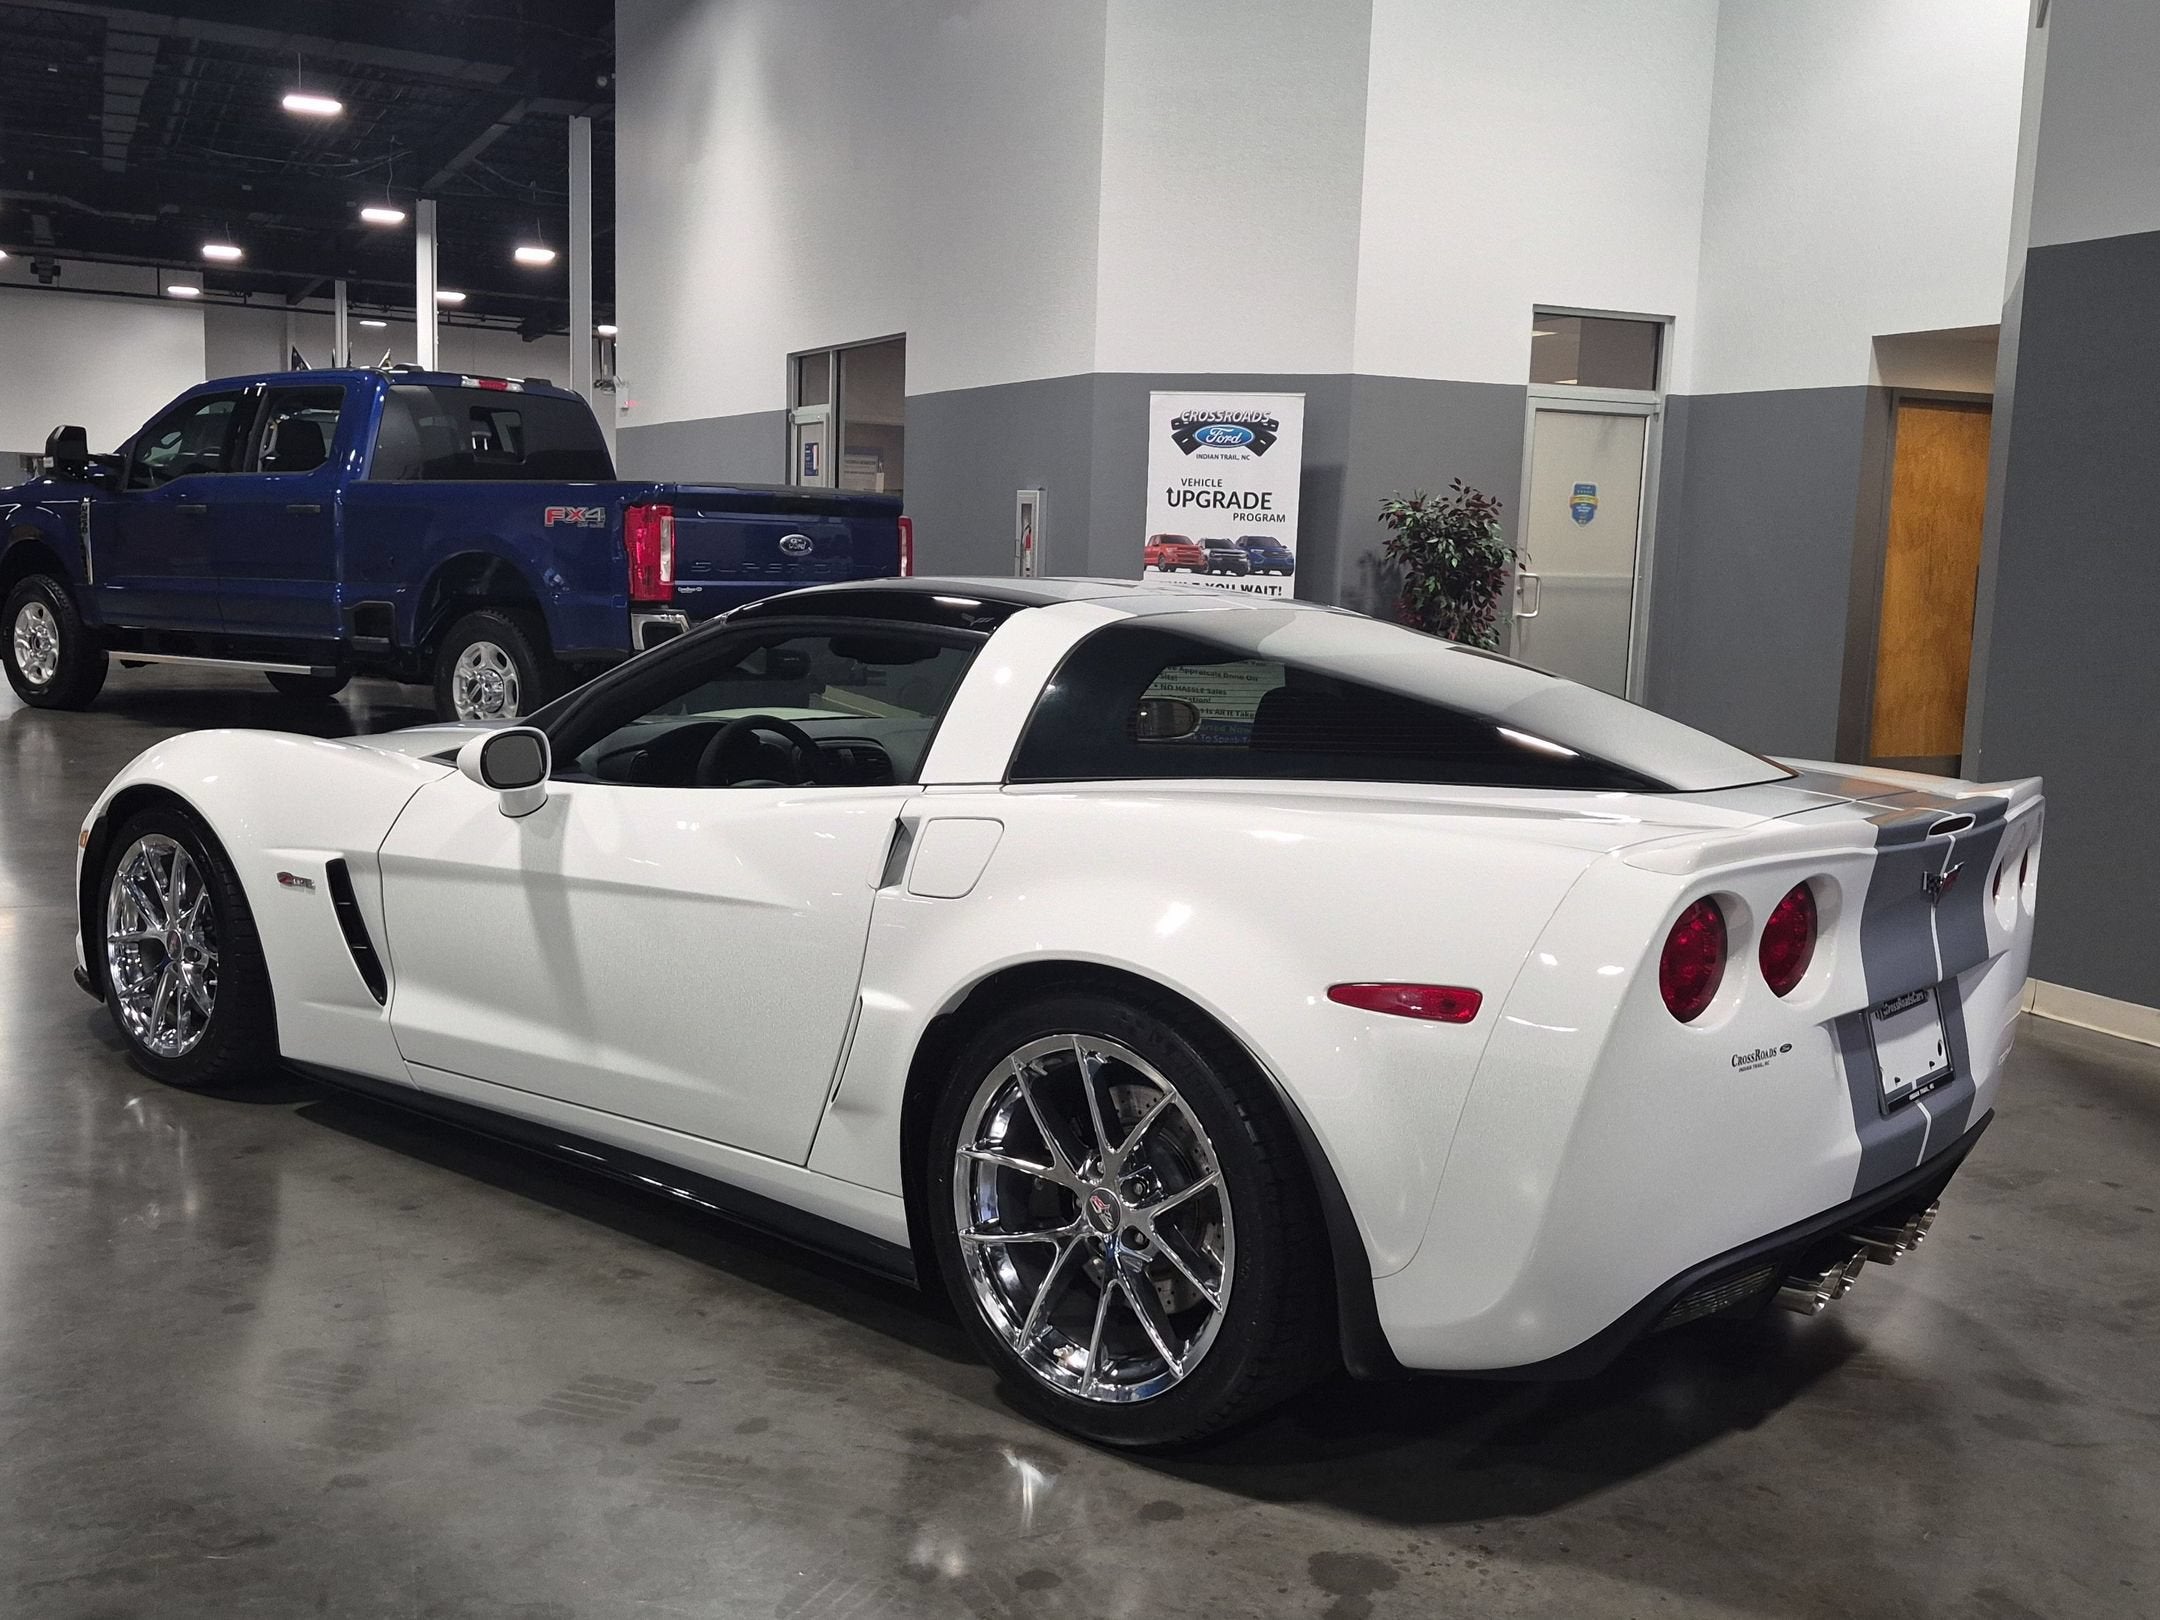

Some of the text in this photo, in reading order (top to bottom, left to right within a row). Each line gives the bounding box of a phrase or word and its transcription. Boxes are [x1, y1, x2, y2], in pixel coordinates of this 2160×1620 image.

[1181, 409, 1271, 423] CROSSROADS
[1205, 427, 1242, 444] Ford
[1181, 478, 1223, 488] VEHICLE
[1166, 488, 1273, 510] UPGRADE
[545, 506, 605, 527] FX4
[1232, 512, 1286, 523] PROGRAM
[1241, 584, 1283, 596] WAIT!
